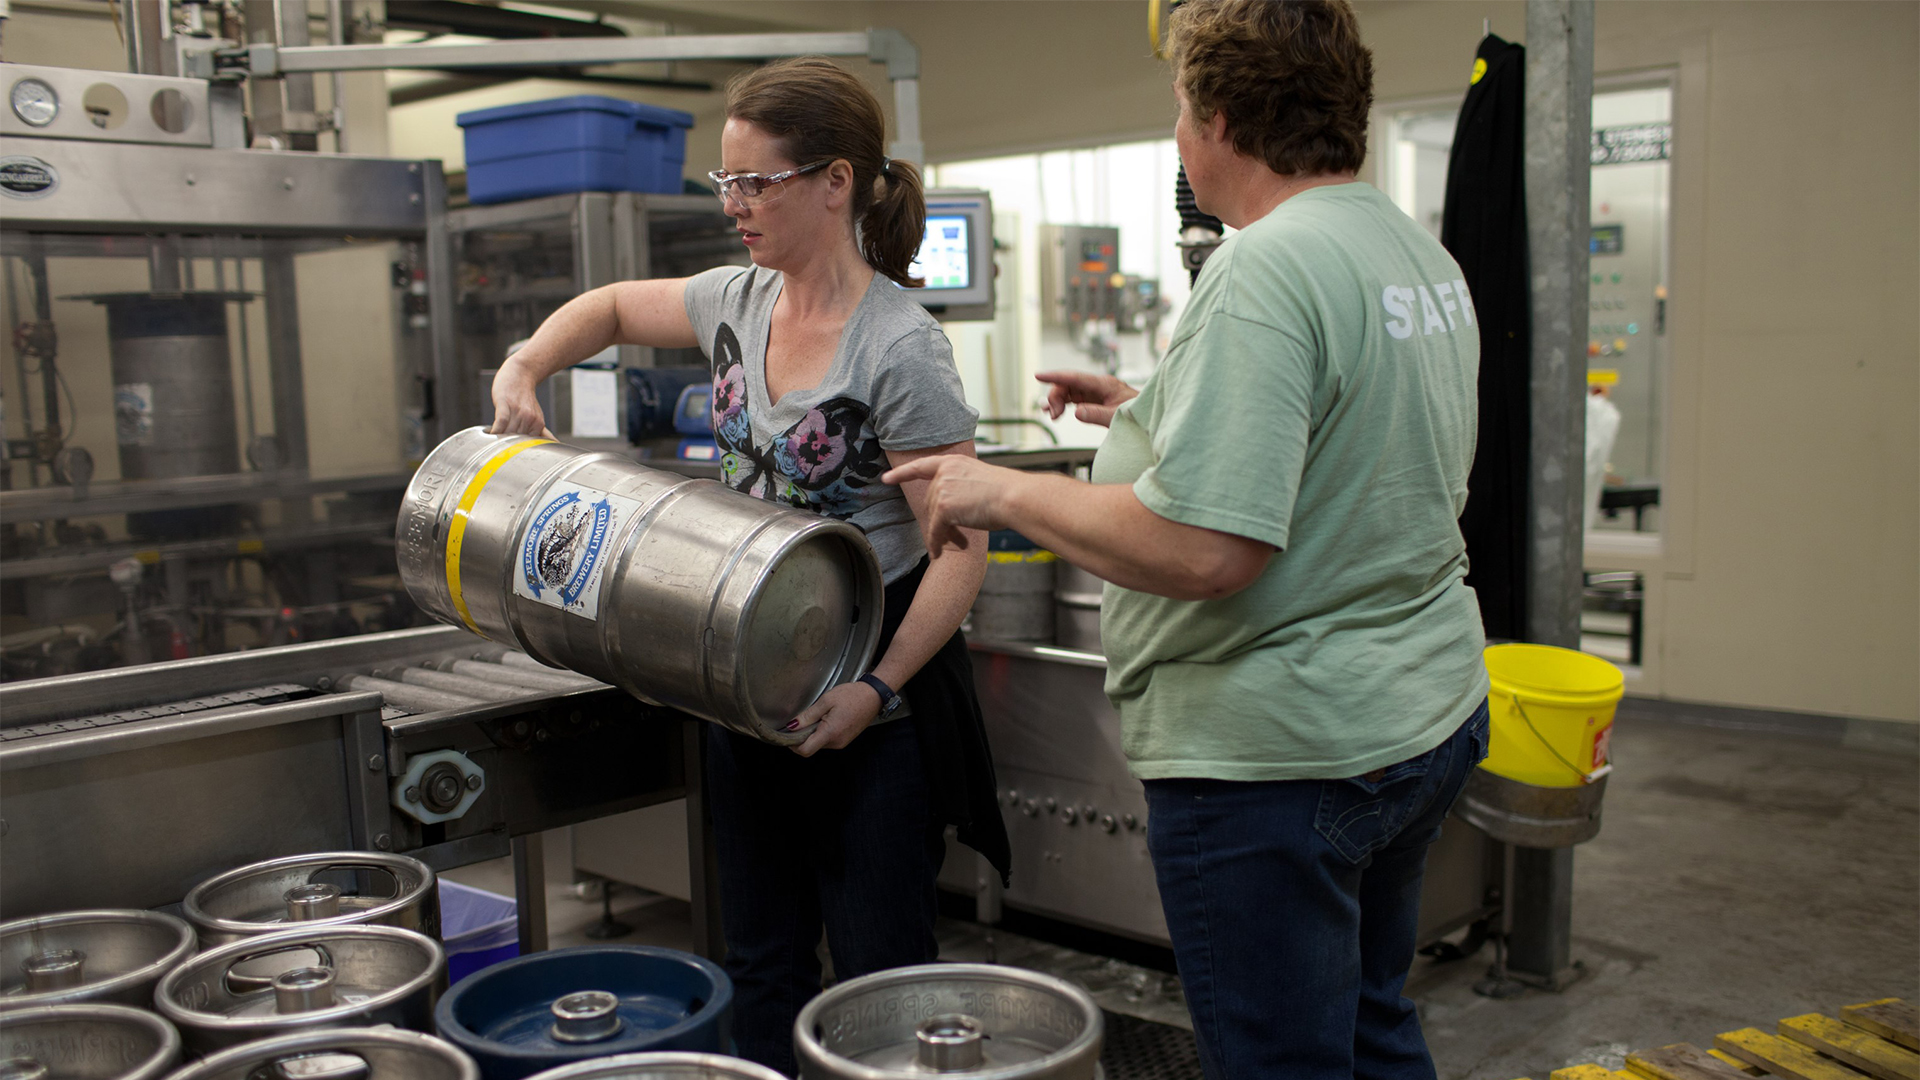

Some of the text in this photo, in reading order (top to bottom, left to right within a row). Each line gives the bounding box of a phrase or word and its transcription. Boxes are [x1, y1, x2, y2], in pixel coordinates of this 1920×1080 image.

[1382, 280, 1472, 340] STAFF
[408, 464, 452, 578] CREEMORE
[525, 495, 570, 582] REEMORE SPRINGS
[568, 508, 607, 597] BREWERY LIMITED
